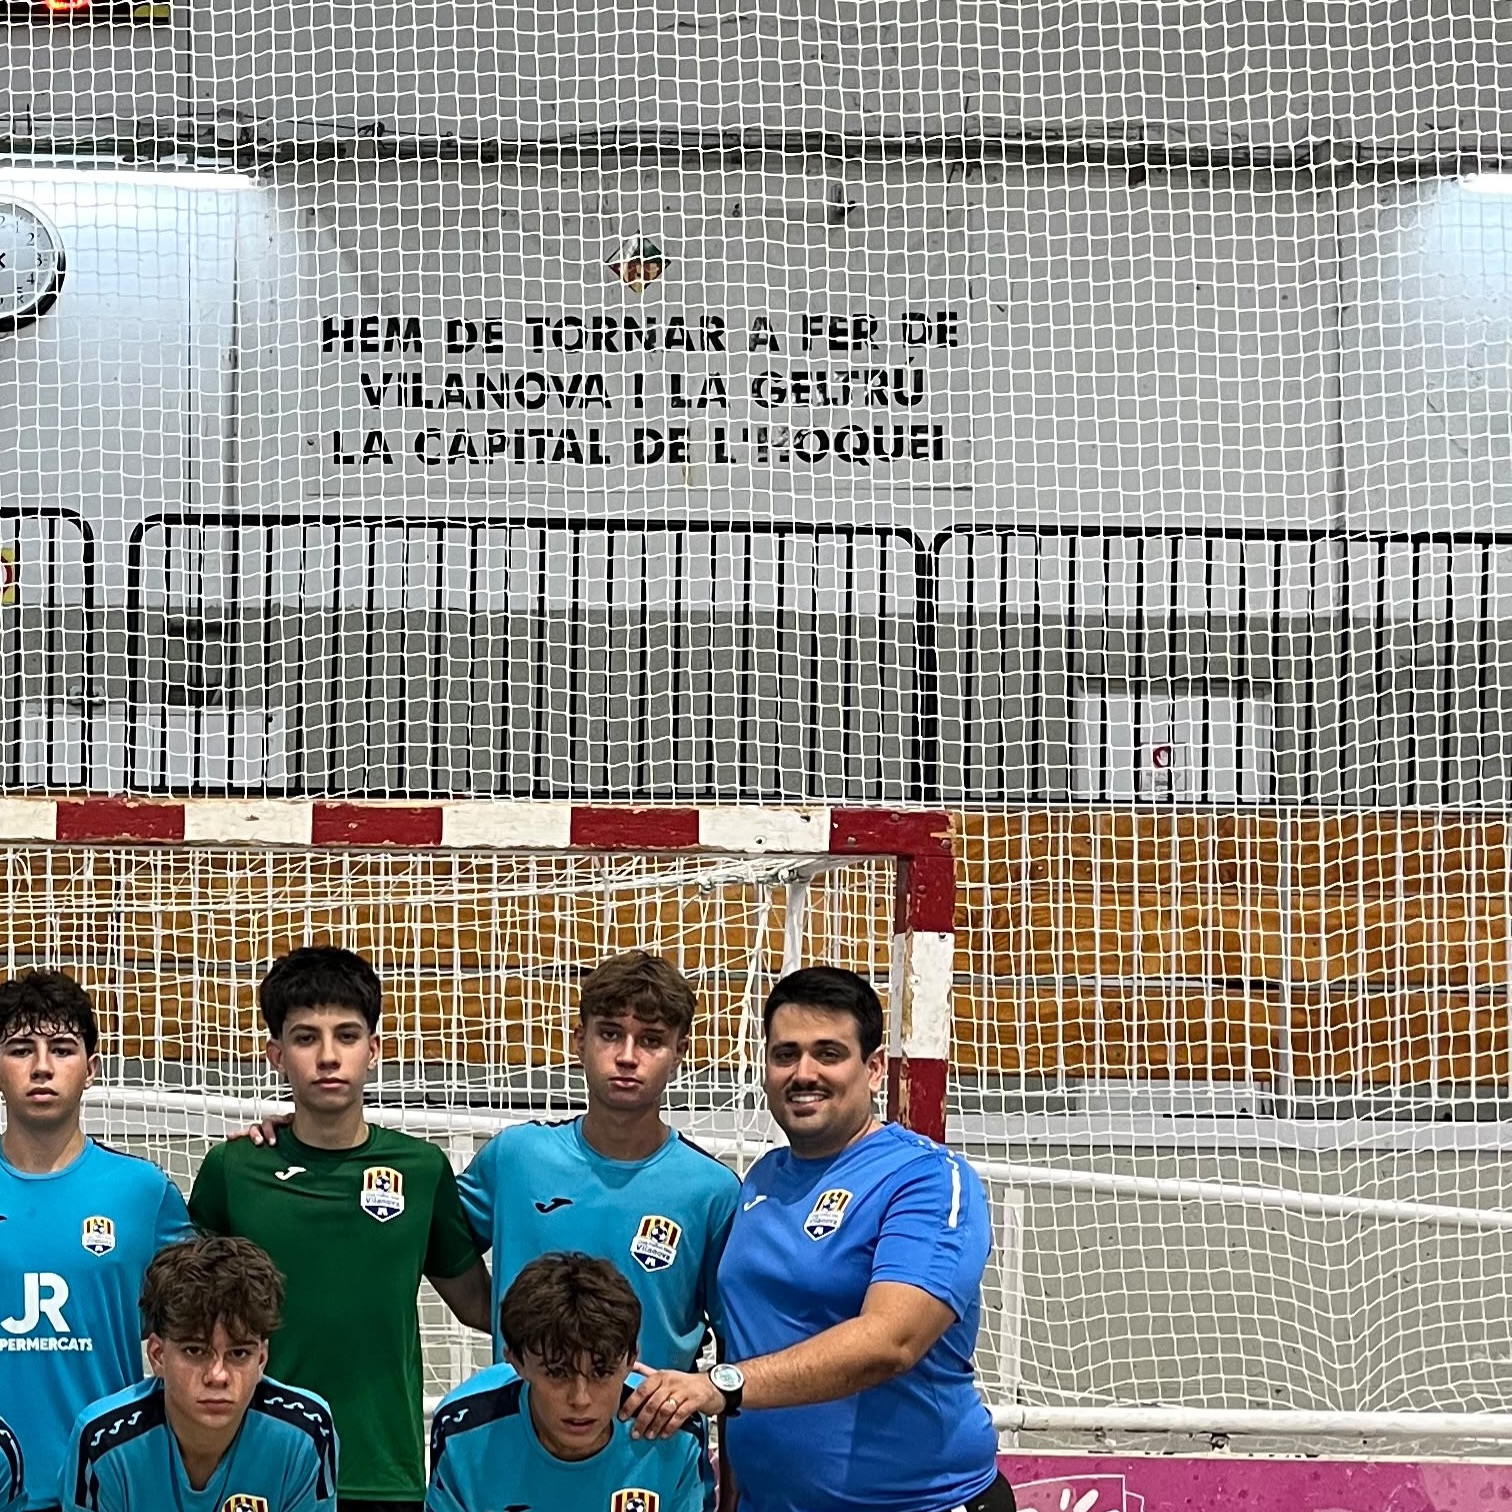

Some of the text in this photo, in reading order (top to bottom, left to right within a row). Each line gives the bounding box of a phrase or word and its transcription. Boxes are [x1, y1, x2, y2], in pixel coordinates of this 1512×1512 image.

[322, 311, 959, 354] HEM DE TORNAR A FER DE
[360, 356, 926, 410] VILANOVA I LA GELTRÚ
[332, 429, 394, 465] LA
[413, 427, 611, 465] CAPITAL
[633, 426, 692, 465] DE
[0, 1272, 71, 1335] JR
